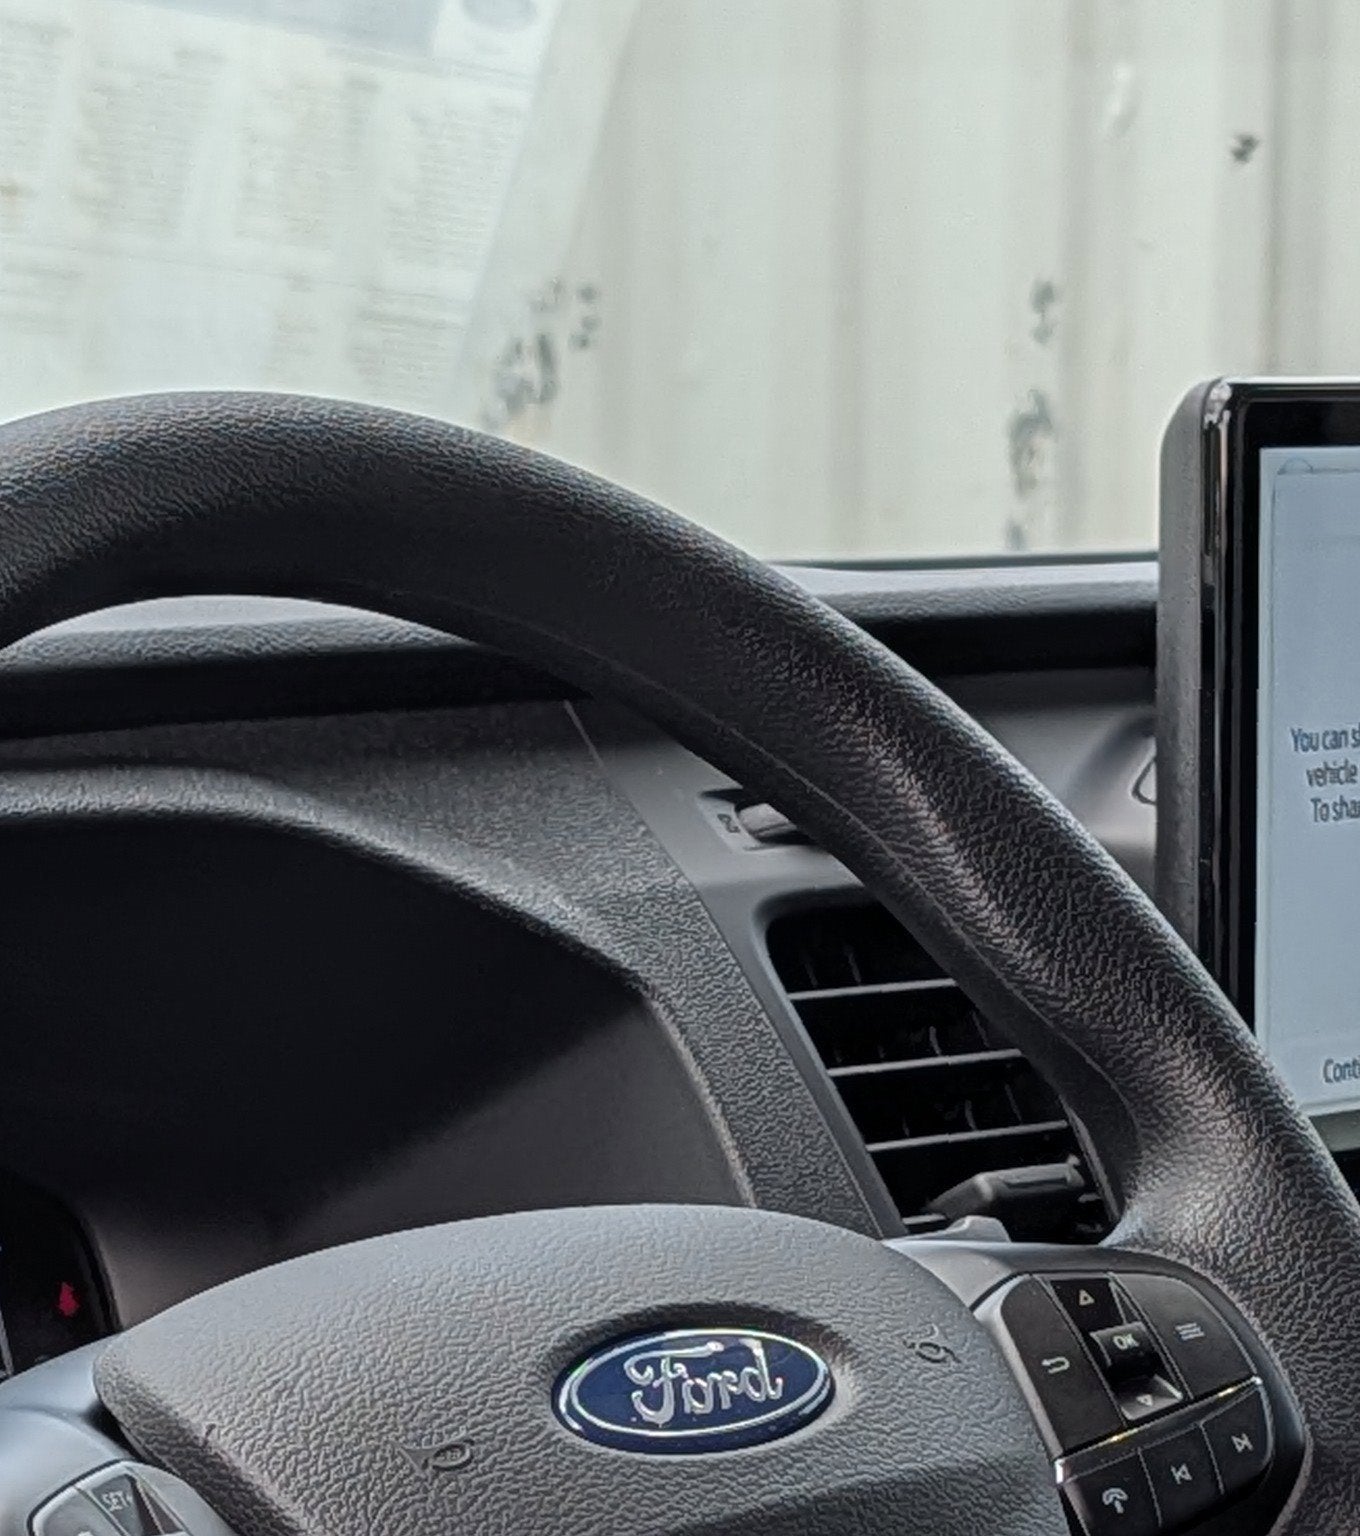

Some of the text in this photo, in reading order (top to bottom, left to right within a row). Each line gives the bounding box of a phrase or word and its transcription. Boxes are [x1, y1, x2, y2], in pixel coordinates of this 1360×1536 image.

[1290, 726, 1319, 752] You
[1322, 727, 1348, 750] can
[1306, 759, 1357, 787] vehicle
[1310, 798, 1330, 823] To
[1112, 1332, 1139, 1351] OK
[623, 1337, 784, 1428] Ford
